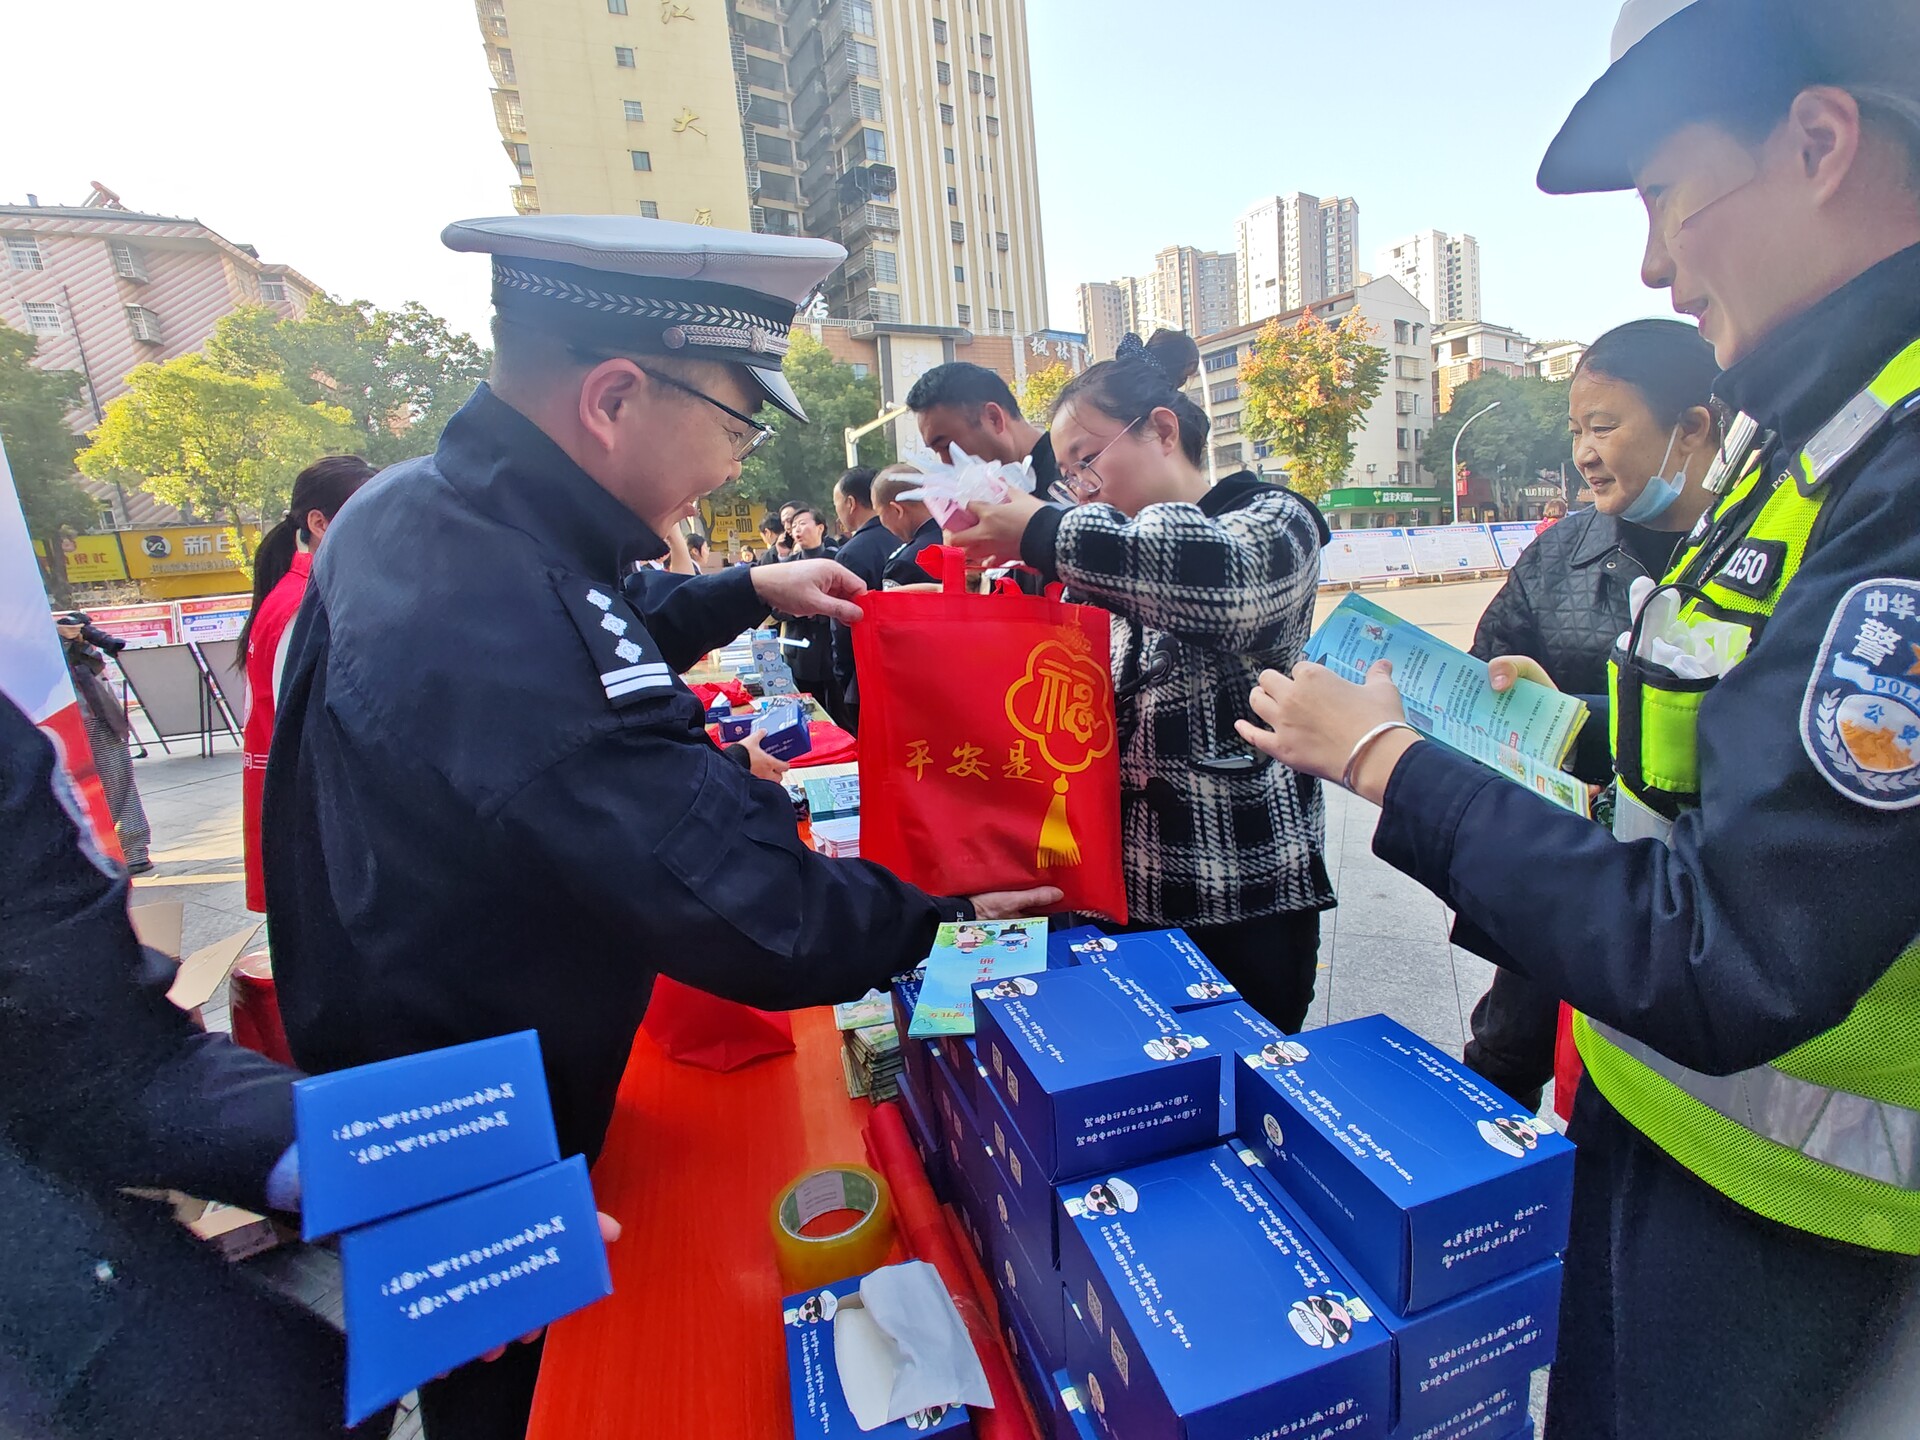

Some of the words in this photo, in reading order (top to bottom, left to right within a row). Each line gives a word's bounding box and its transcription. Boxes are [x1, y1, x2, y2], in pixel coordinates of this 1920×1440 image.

[1864, 589, 1920, 622] 中华
[905, 739, 1045, 784] 平安是
